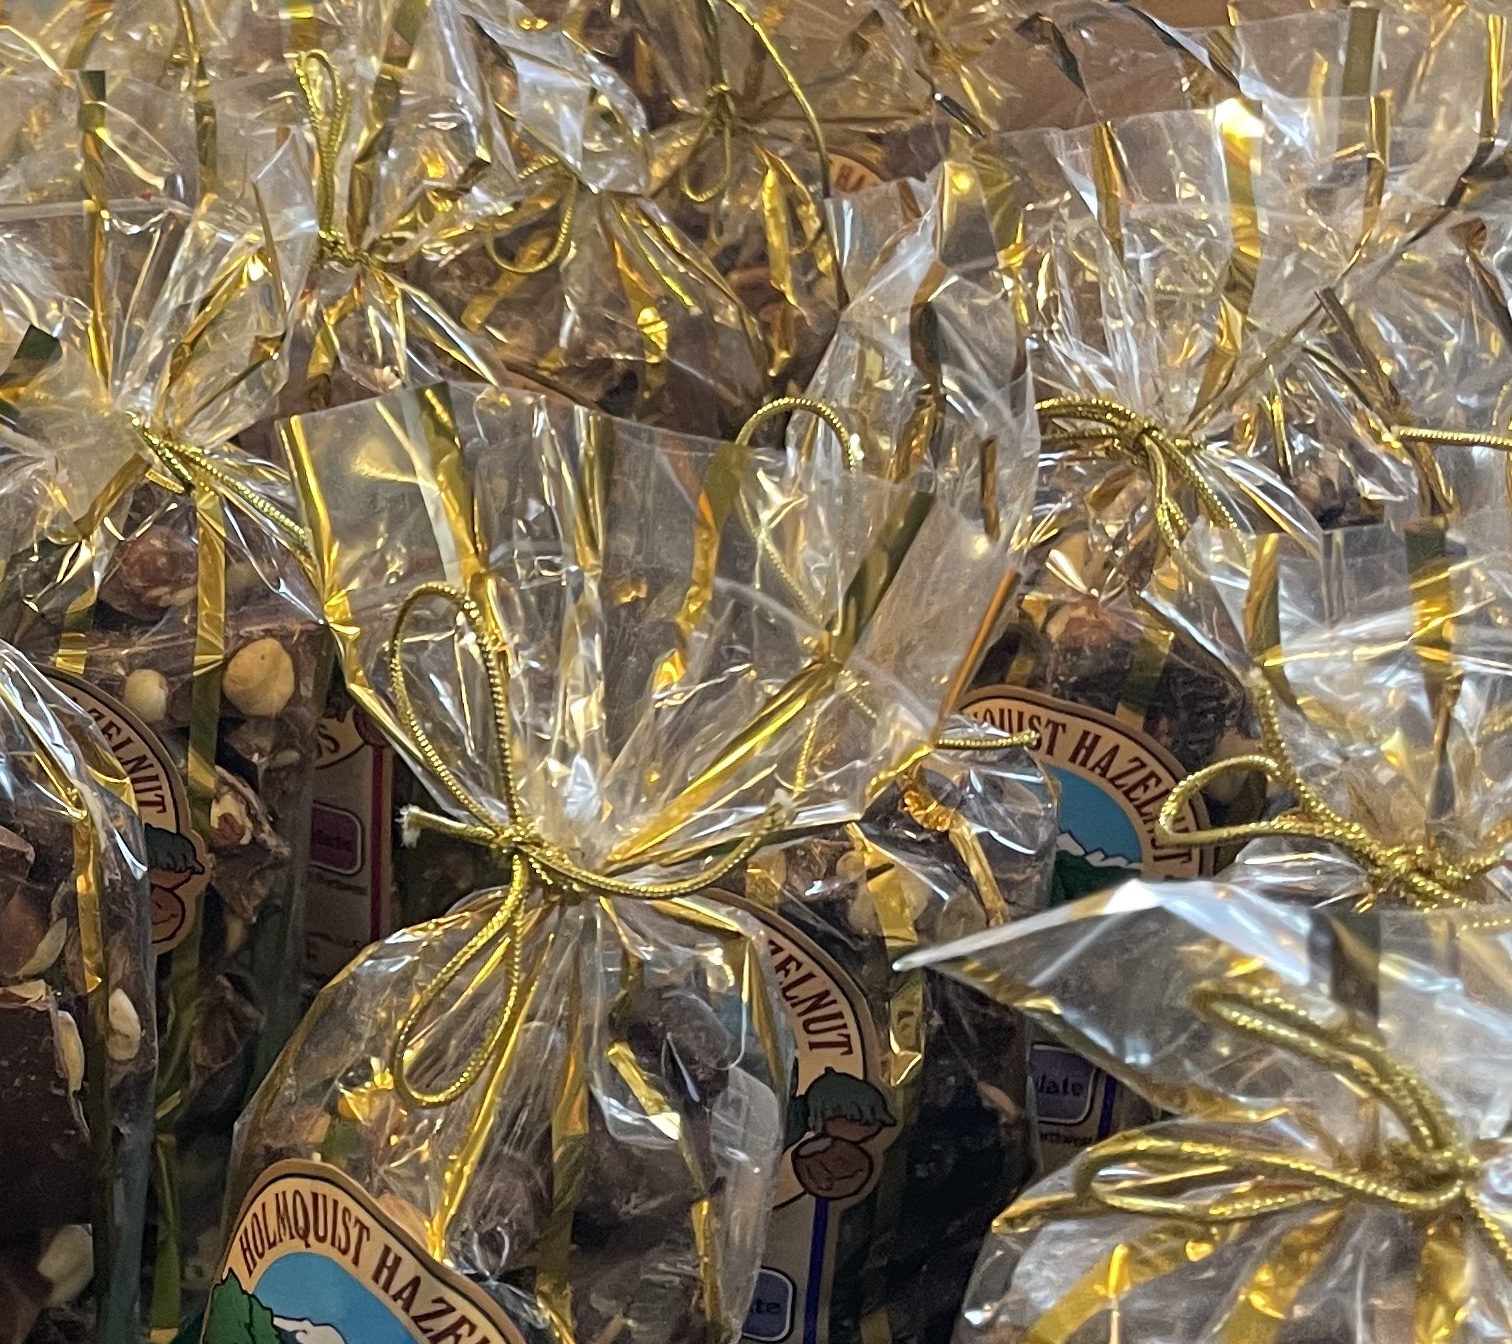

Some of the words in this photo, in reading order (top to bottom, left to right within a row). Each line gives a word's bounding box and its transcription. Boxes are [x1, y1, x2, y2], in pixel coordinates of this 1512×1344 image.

[86, 706, 167, 816] ELNUT
[972, 707, 1066, 757] QUIST
[1068, 729, 1193, 865] HAZELT
[767, 939, 854, 1057] ELNUT
[239, 1188, 371, 1280] HOLMQUIST
